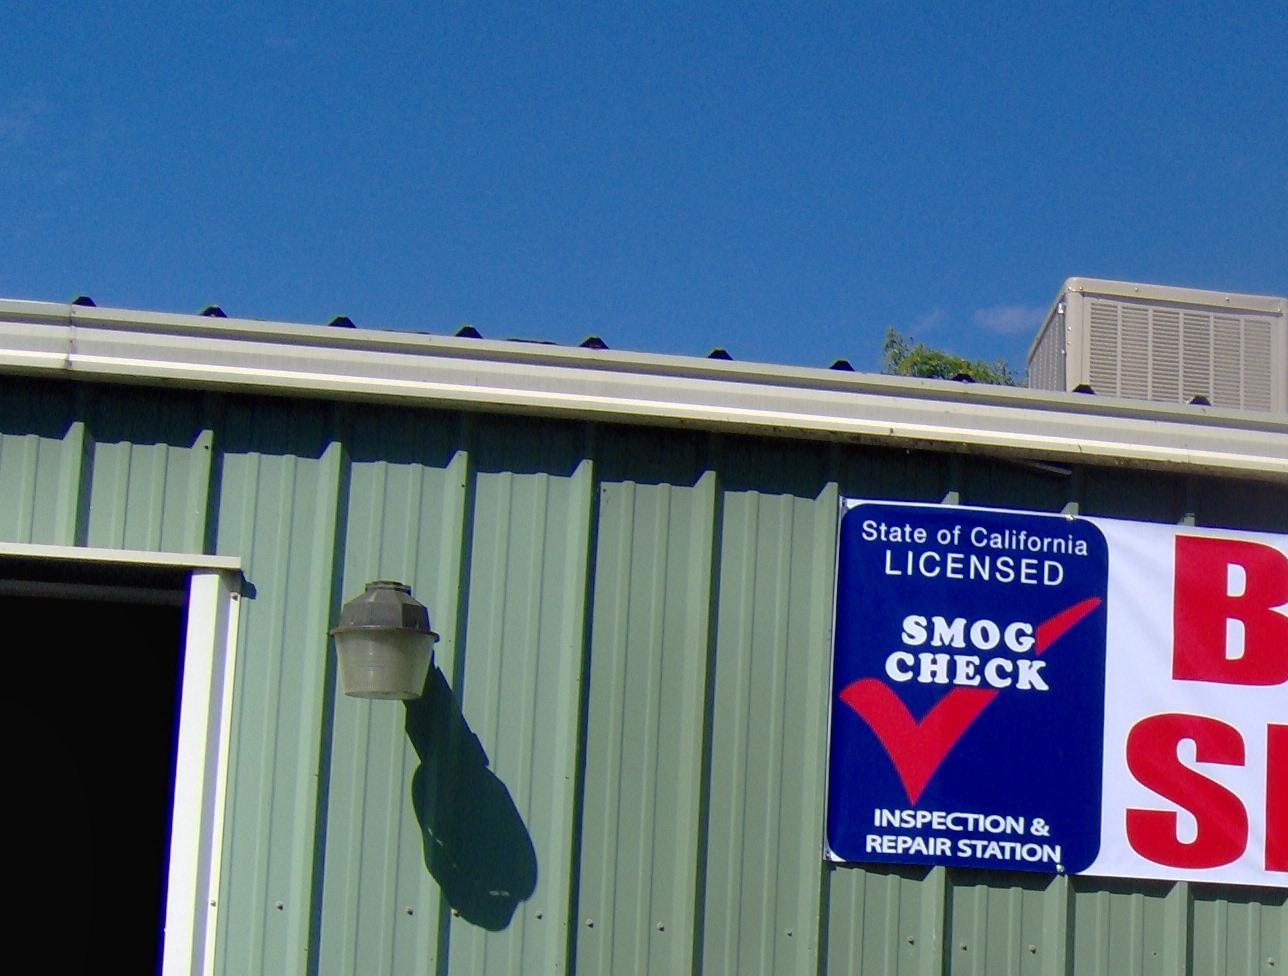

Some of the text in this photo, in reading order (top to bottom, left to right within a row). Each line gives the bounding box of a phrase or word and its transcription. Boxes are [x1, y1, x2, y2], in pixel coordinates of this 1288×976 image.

[862, 520, 1088, 556] State of California
[885, 550, 1064, 586] LICENSED
[901, 615, 1036, 652] SMOG
[885, 650, 1049, 691] CHECK
[874, 808, 1050, 837] INSPECTION &
[865, 835, 1061, 863] REPAIR STATION
